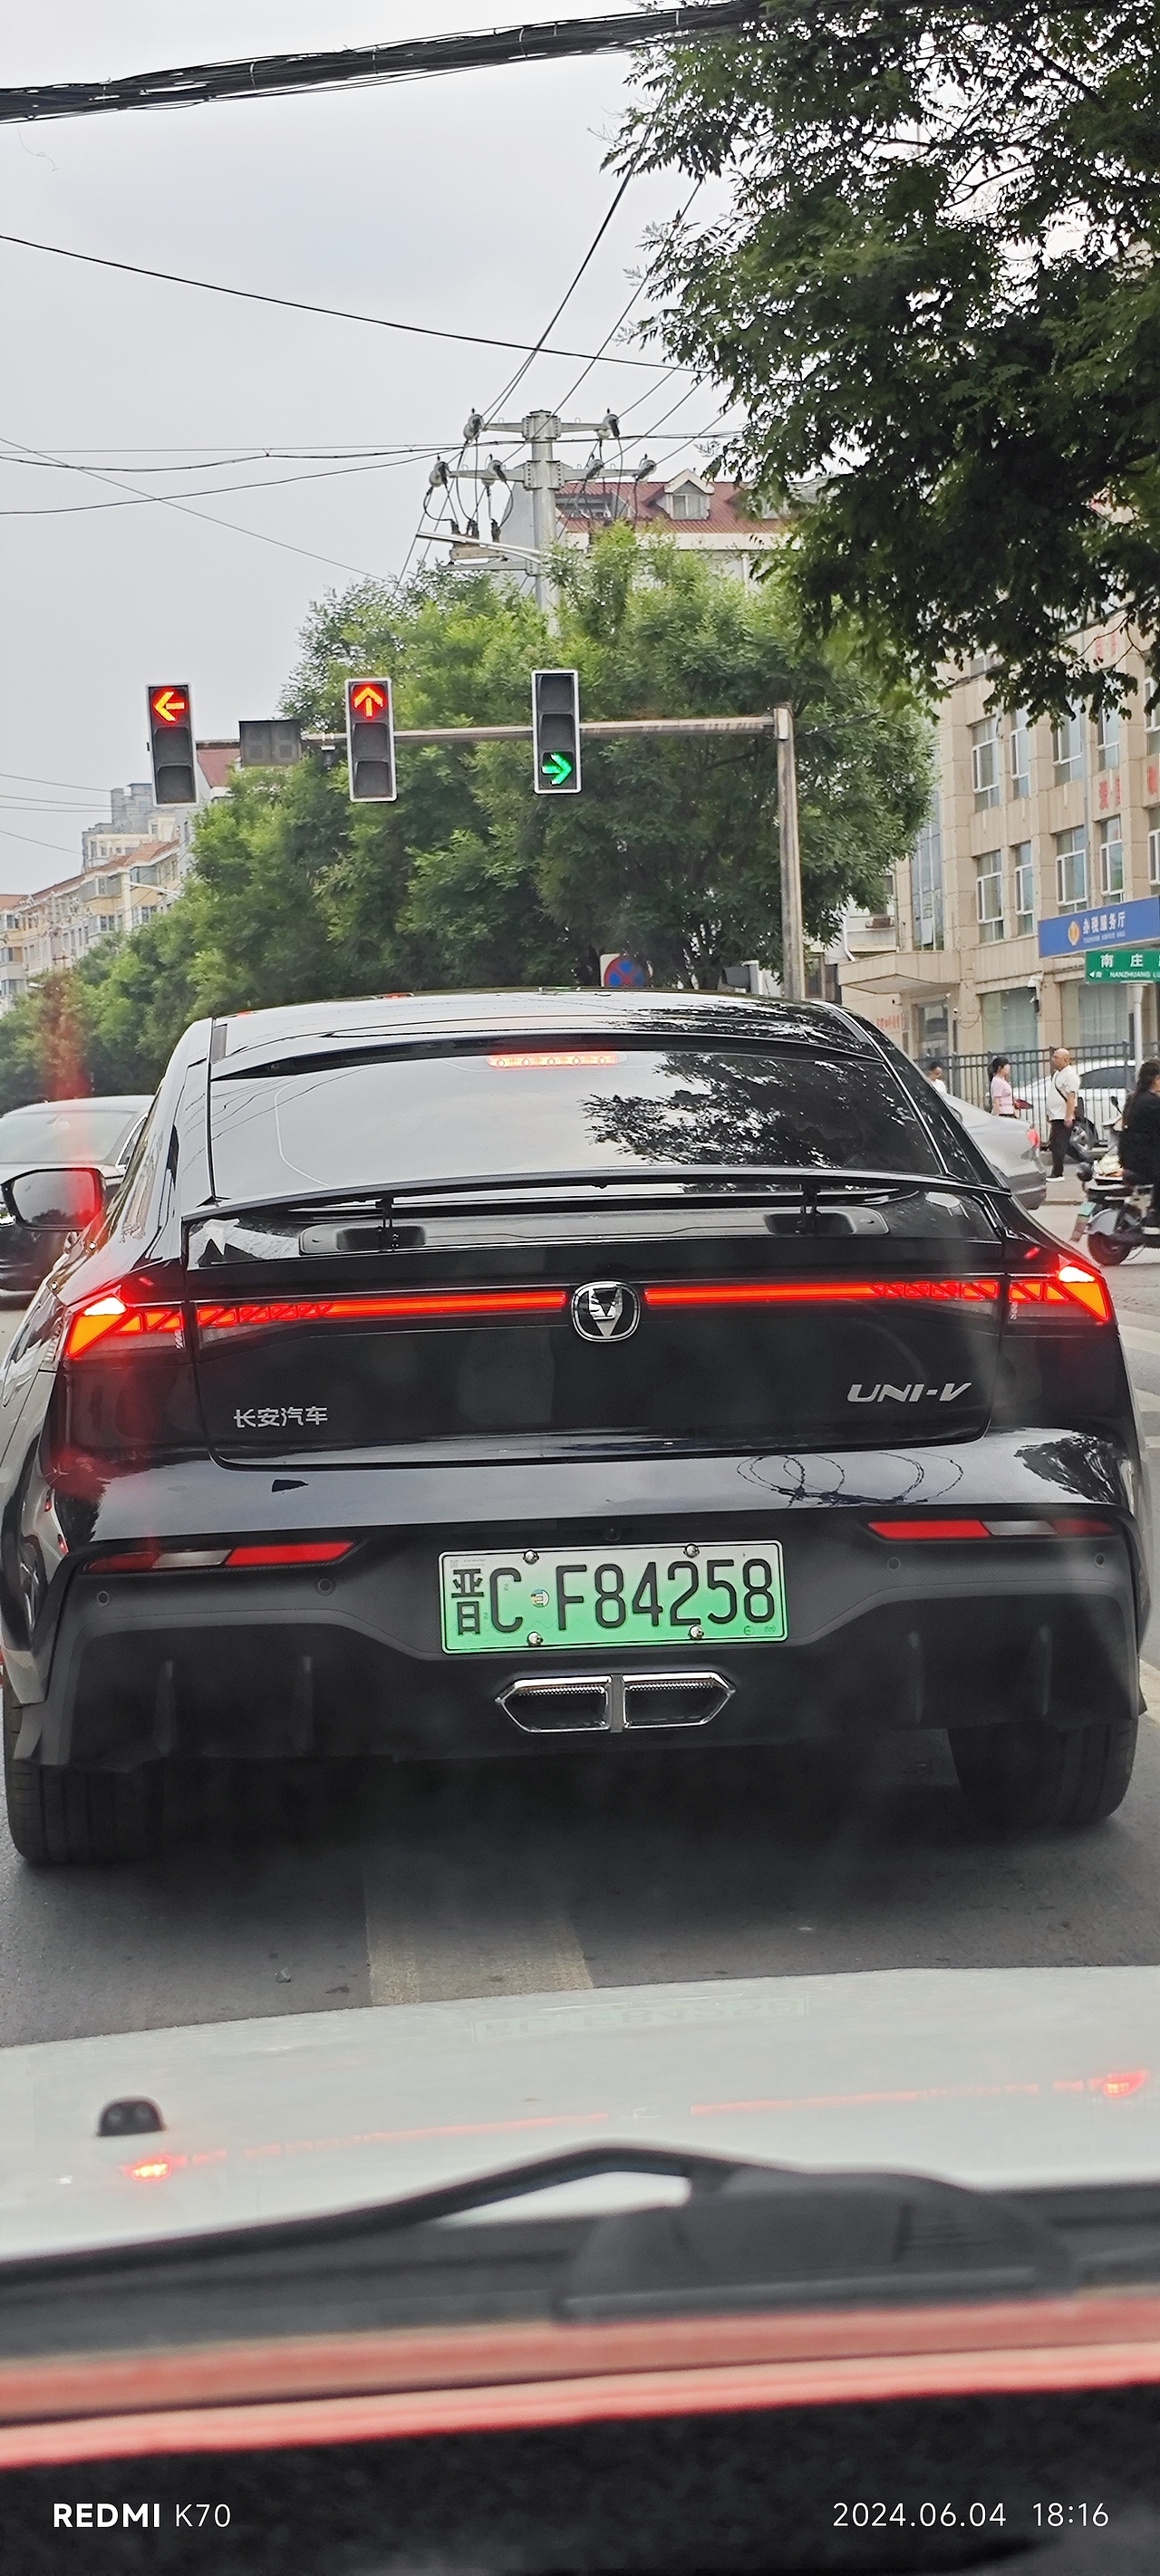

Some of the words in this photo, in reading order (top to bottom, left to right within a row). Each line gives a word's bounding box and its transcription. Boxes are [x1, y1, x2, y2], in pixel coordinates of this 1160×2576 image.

[1082, 911, 1126, 934] 办税服务厅
[1100, 953, 1160, 968] 南庄
[846, 1382, 972, 1403] UNI-V
[233, 1406, 328, 1428] 长安汽车
